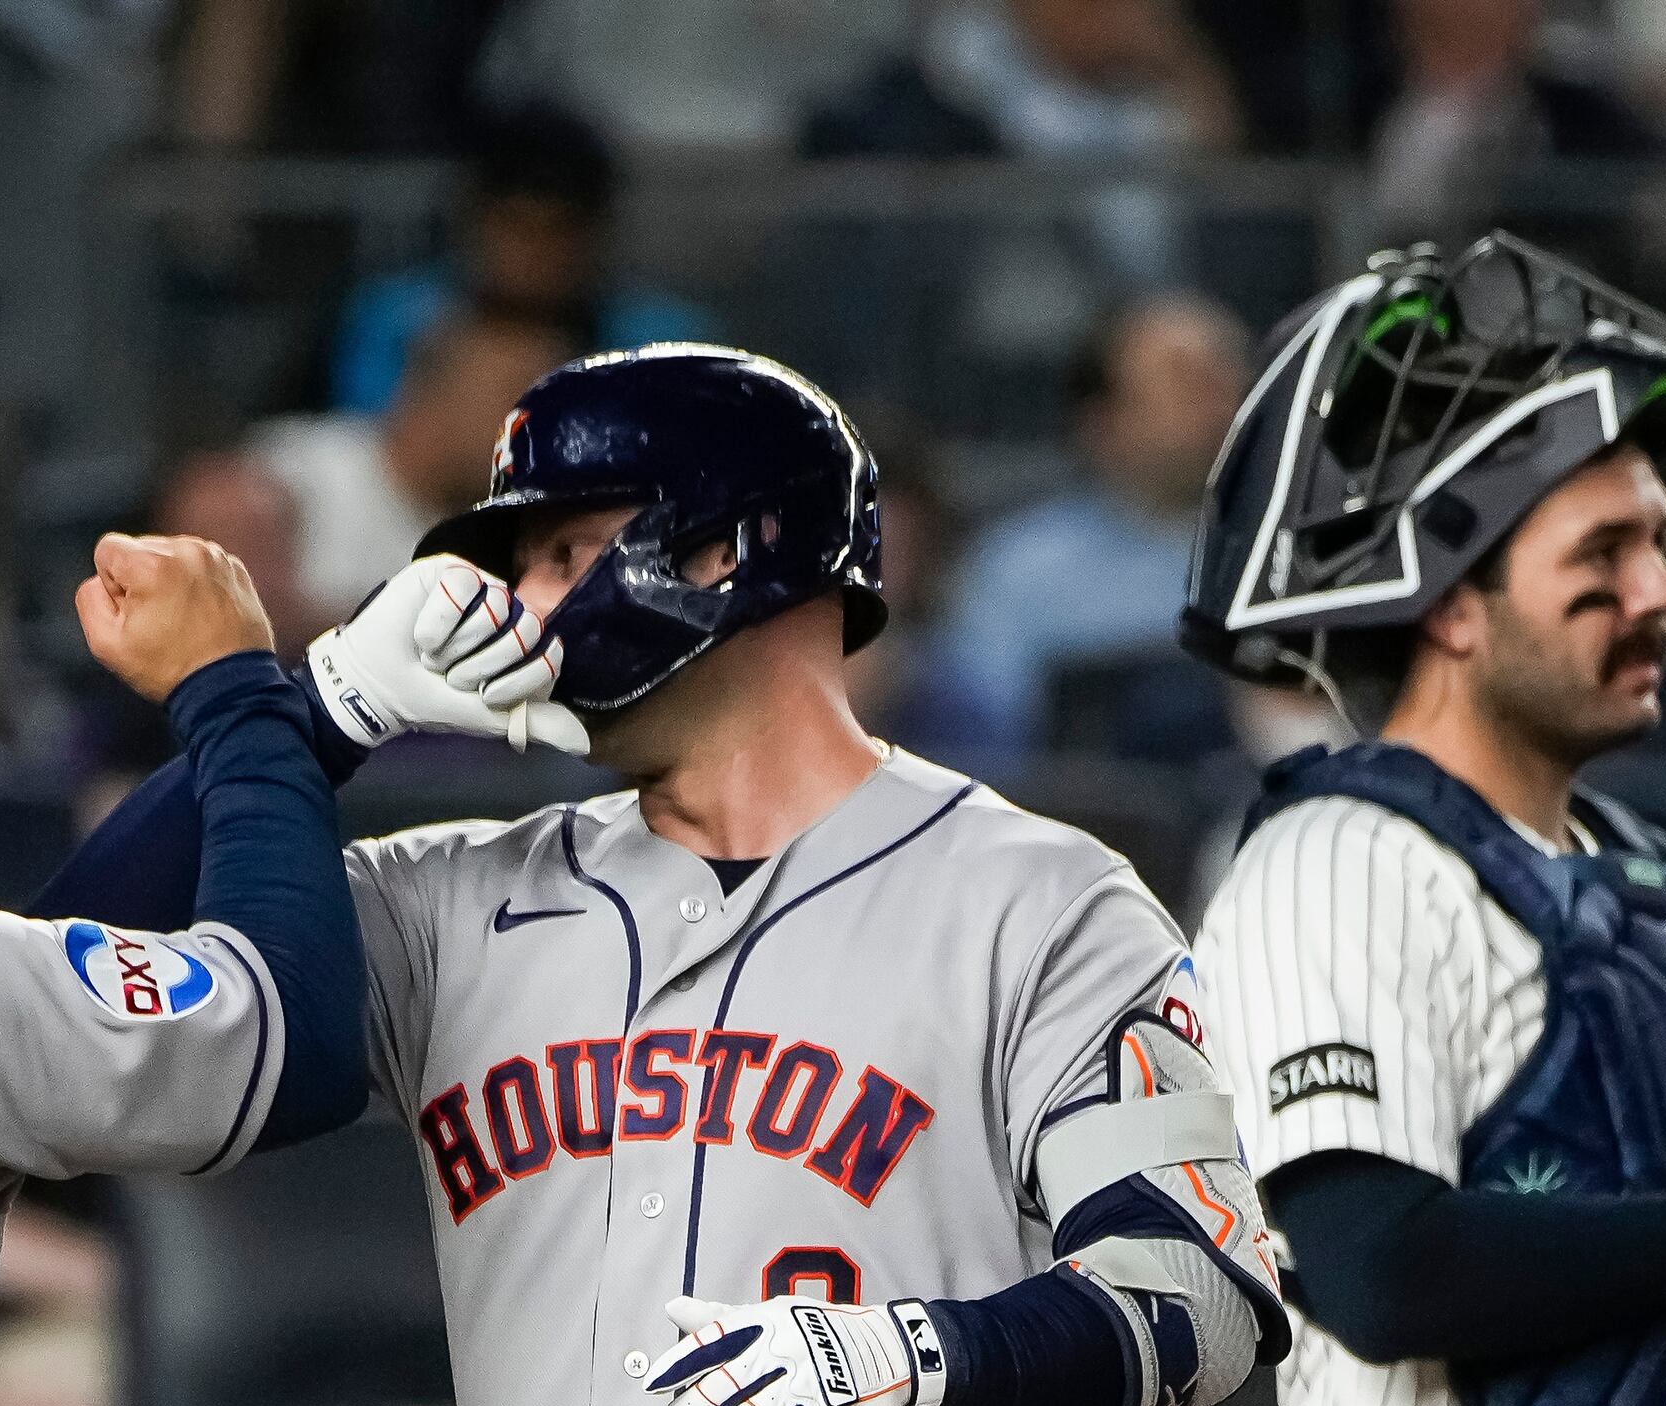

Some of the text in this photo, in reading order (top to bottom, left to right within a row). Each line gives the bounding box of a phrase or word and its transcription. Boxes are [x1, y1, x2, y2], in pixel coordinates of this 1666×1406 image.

[106, 927, 164, 1017] OXY
[1268, 1049, 1375, 1105] STARR
[419, 1027, 936, 1226] HOUSTON
